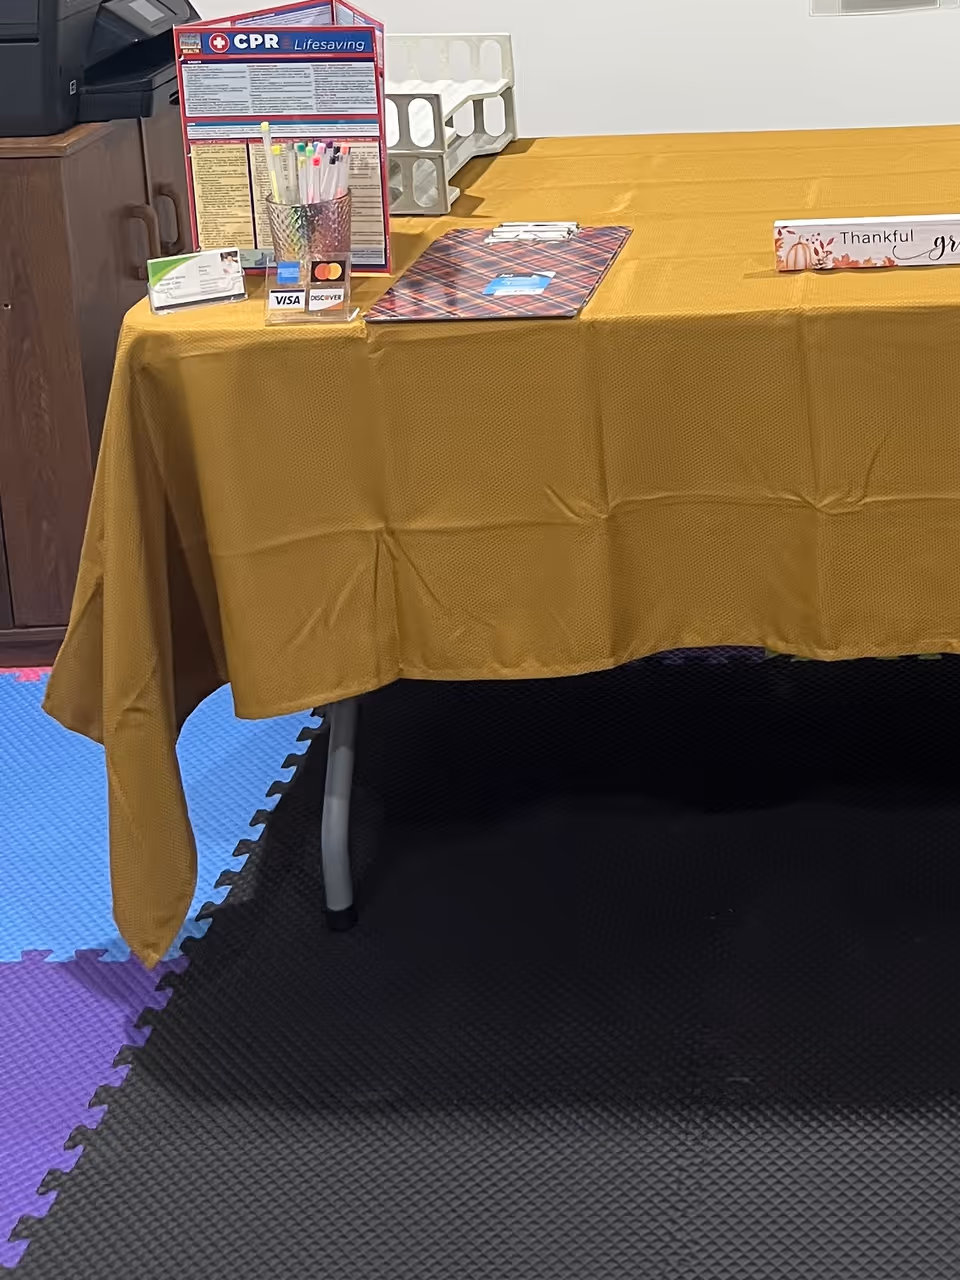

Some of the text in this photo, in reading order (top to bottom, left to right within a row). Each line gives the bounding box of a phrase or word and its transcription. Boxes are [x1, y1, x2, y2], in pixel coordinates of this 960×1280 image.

[233, 33, 280, 49] CPR
[294, 38, 365, 52] Lifesaving
[839, 228, 915, 246] Thankful
[274, 295, 301, 306] VISA
[310, 294, 342, 302] DISCOVER
